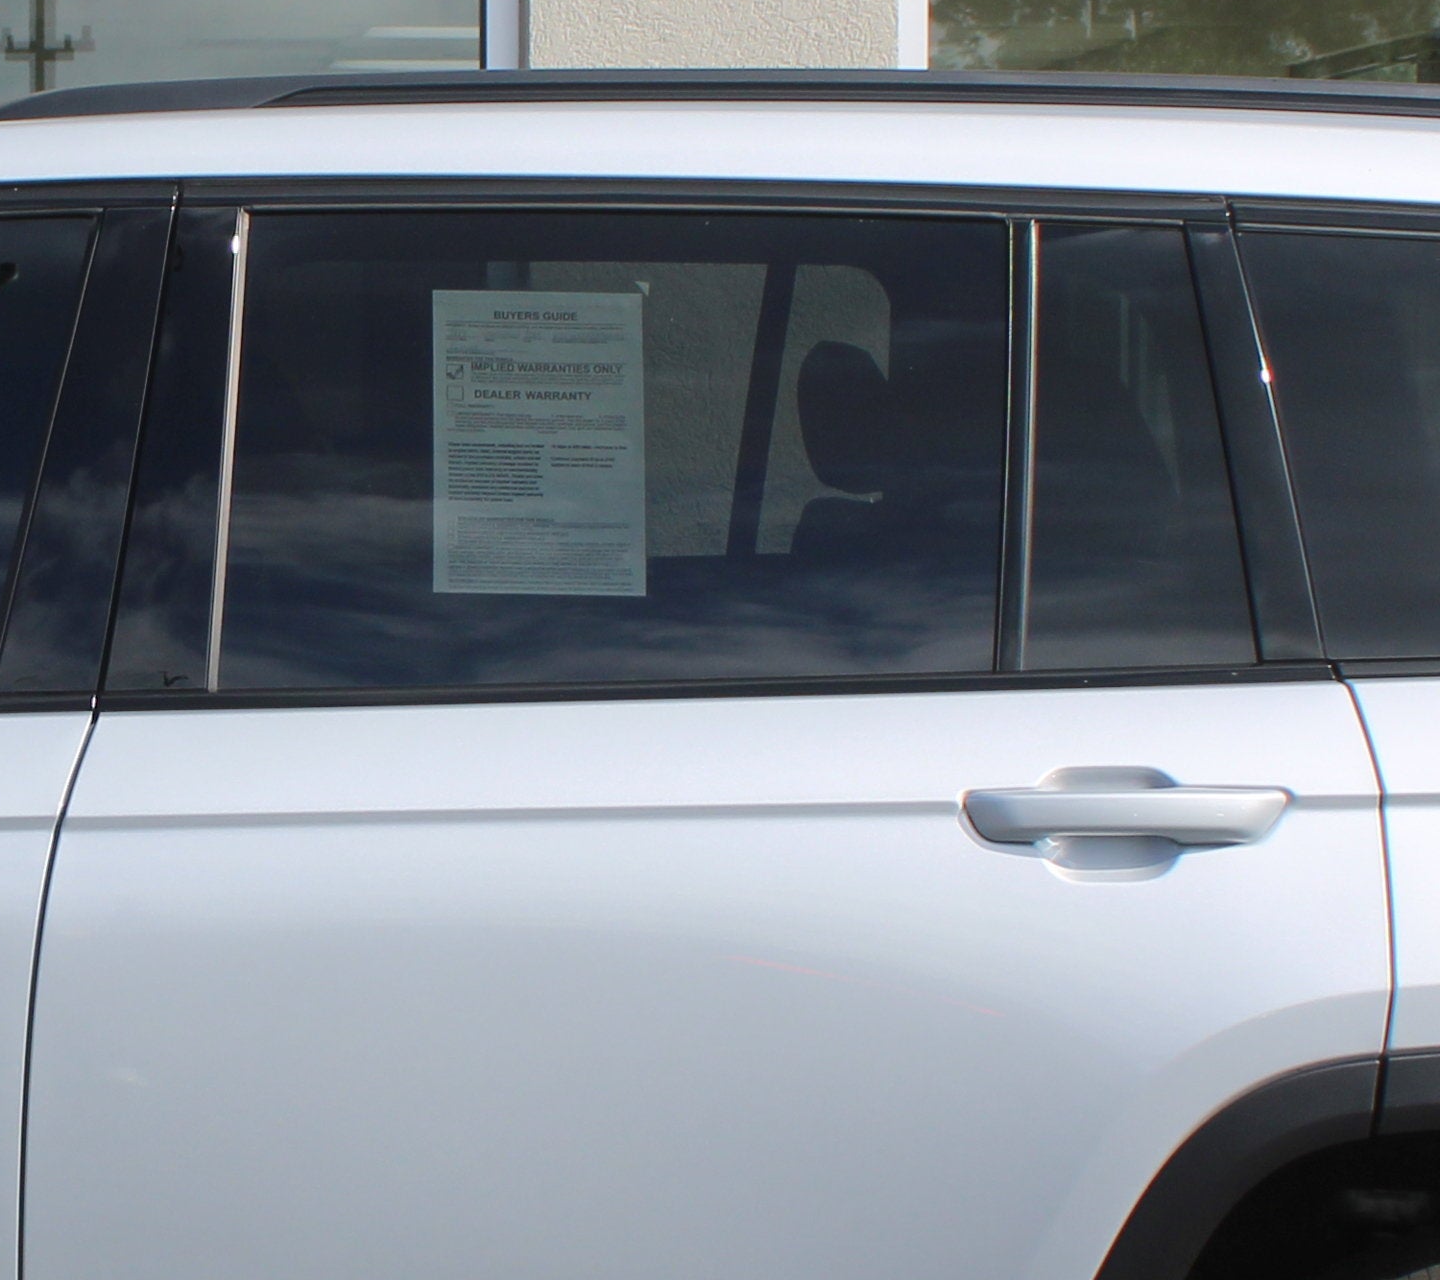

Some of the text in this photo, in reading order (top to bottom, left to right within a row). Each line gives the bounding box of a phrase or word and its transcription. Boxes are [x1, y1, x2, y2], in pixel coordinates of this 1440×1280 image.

[493, 311, 578, 322] BUYERS GUIDE
[471, 362, 622, 374] IMPLIED WARRANTIES ONLY
[474, 389, 592, 401] DEALER WARRANTY
